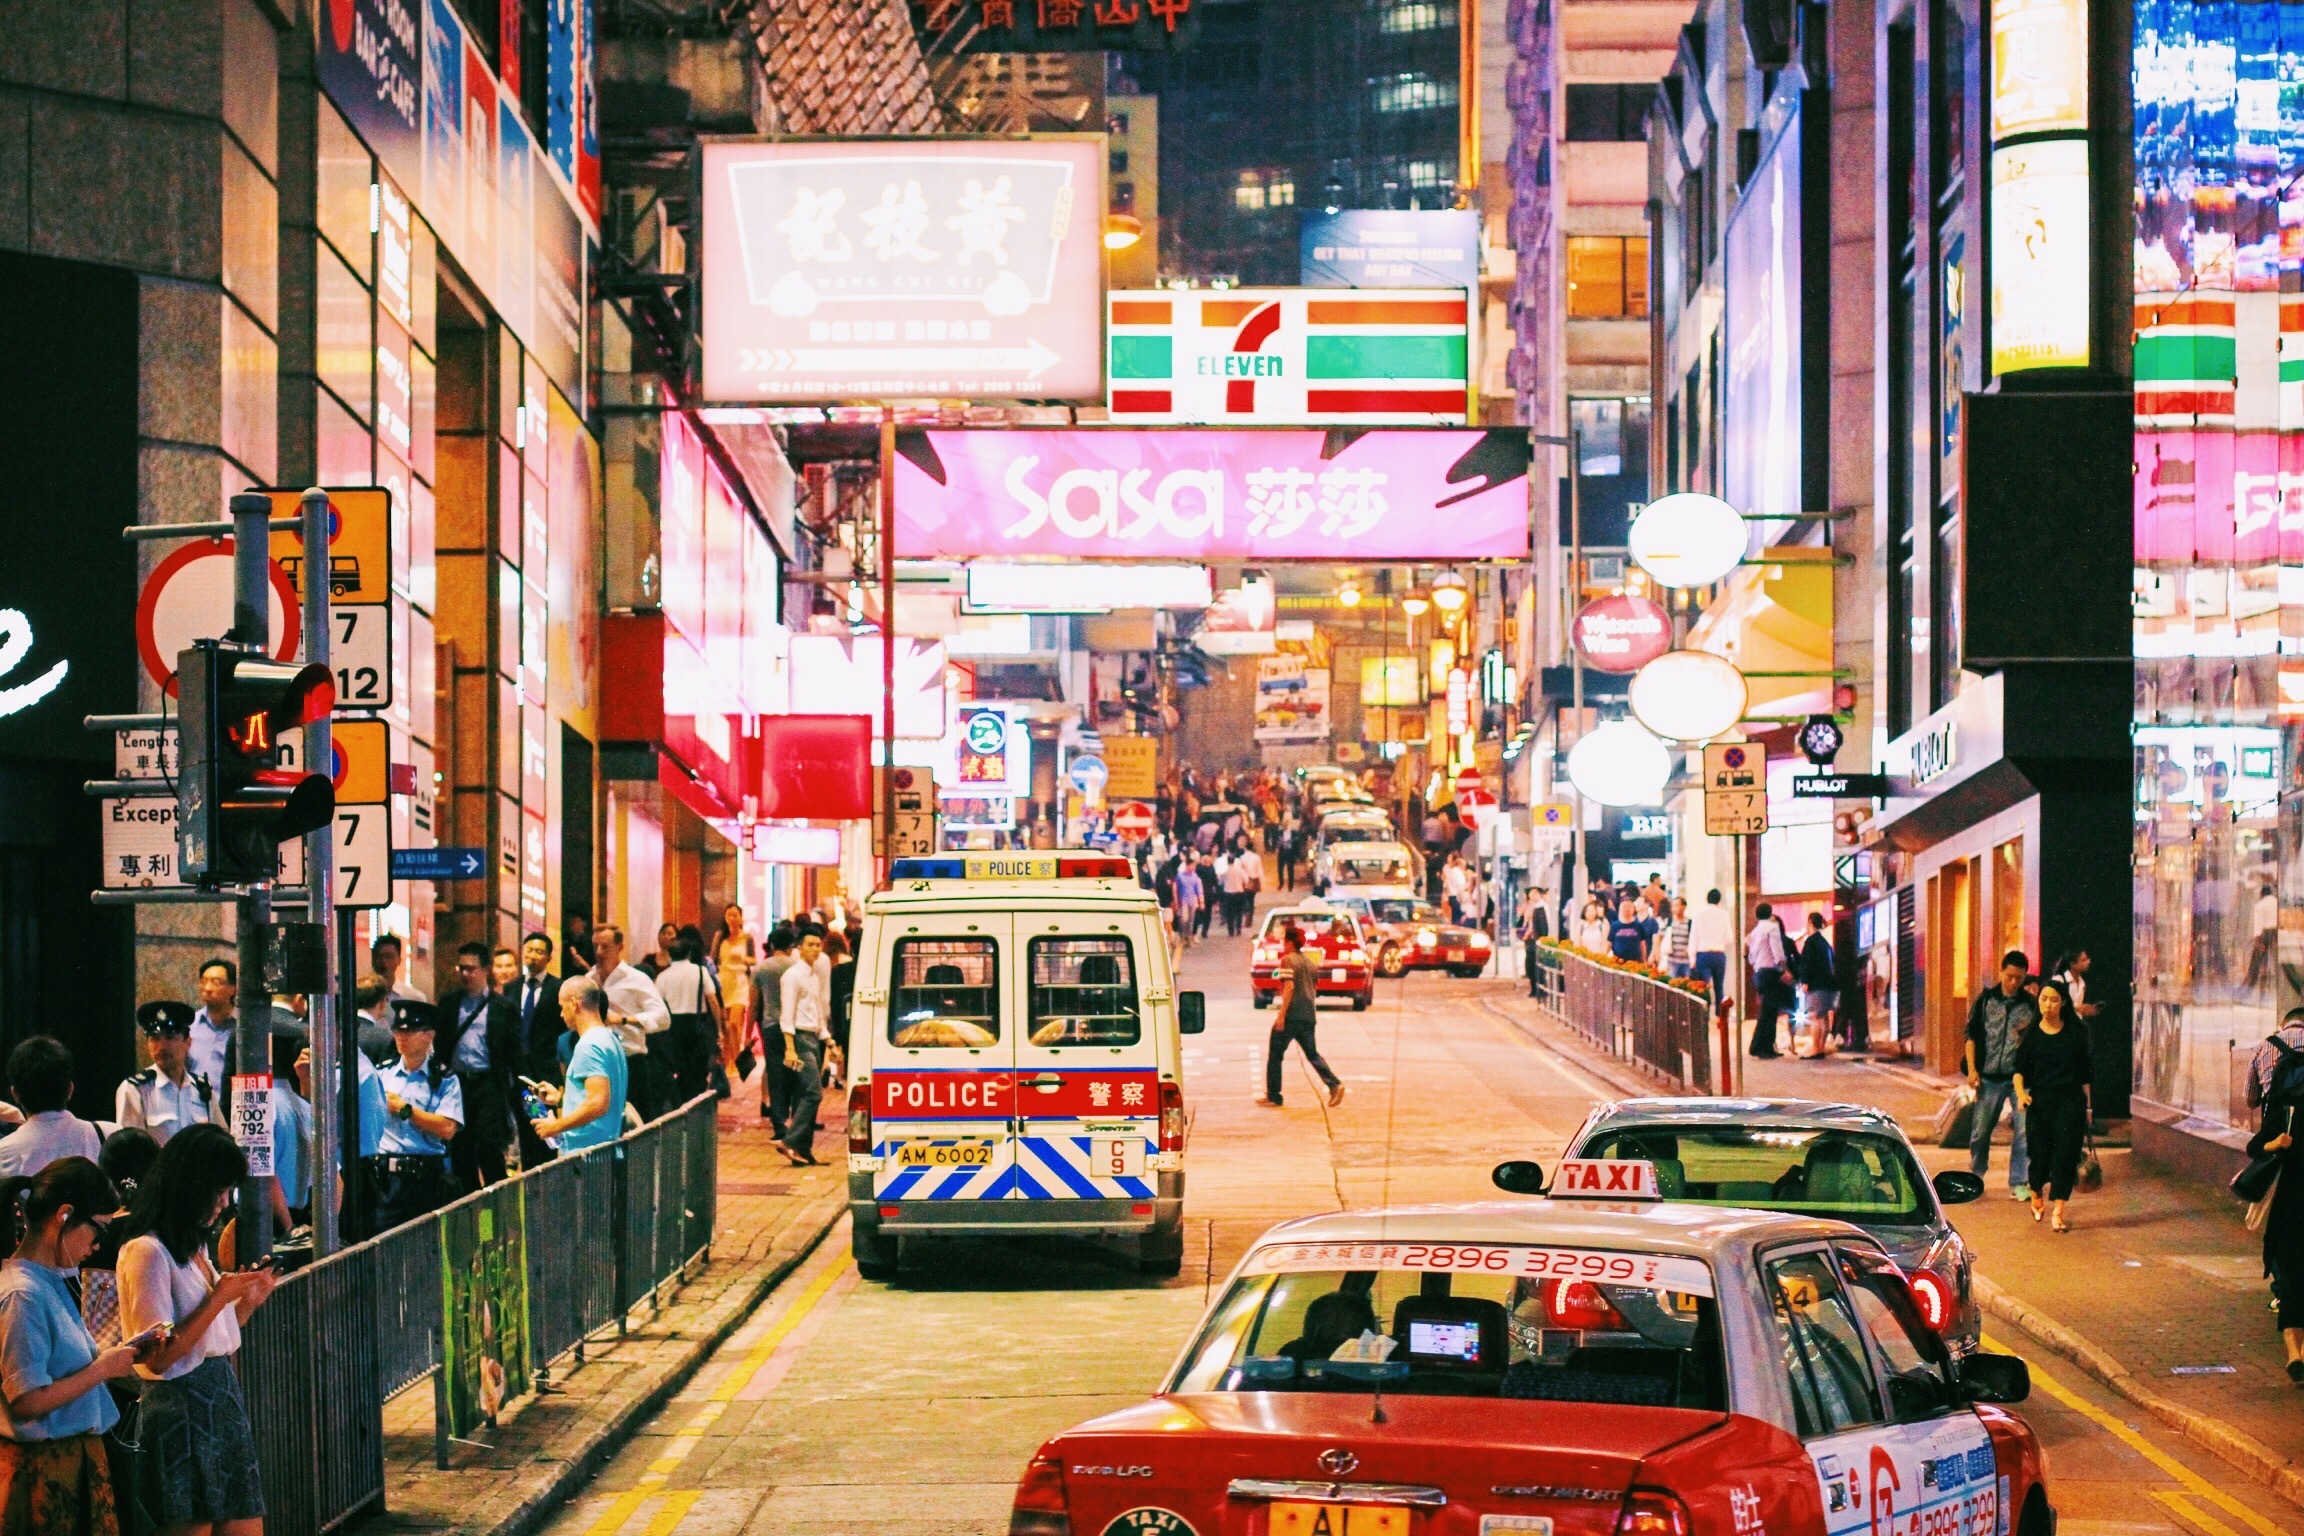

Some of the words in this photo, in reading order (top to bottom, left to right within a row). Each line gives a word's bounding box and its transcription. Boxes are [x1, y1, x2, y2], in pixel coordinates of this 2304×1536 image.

[1245, 466, 1389, 540] 莎莎
[335, 612, 359, 644] 7
[1581, 634, 1631, 653] Wine
[337, 667, 379, 699] 12
[123, 735, 169, 751] Length
[1911, 721, 1958, 788] HUBLOT
[1795, 779, 1848, 793] HUBLOT
[1744, 794, 1754, 808] 7
[112, 805, 179, 825] Except
[911, 816, 921, 831] 7
[1746, 816, 1764, 831] 12
[338, 813, 361, 846] 7
[911, 840, 929, 853] 12
[969, 862, 983, 876] 警
[988, 861, 1032, 876] POLICE
[1038, 862, 1053, 876] 察
[339, 866, 362, 898] 7
[886, 1082, 999, 1108] POLICE
[1088, 1081, 1145, 1107] 警察
[241, 1122, 265, 1136] 792
[901, 1148, 927, 1163] AM
[935, 1147, 989, 1163] 6002
[1110, 1140, 1125, 1157] C
[1110, 1158, 1125, 1174] 9
[1563, 1163, 1641, 1191] TAXI
[1402, 1246, 1510, 1270] 2896
[1525, 1251, 1634, 1279] 3299
[1116, 1465, 1154, 1477] LPG
[1126, 1511, 1179, 1531] TAXI
[1963, 1490, 1996, 1536] 3299
